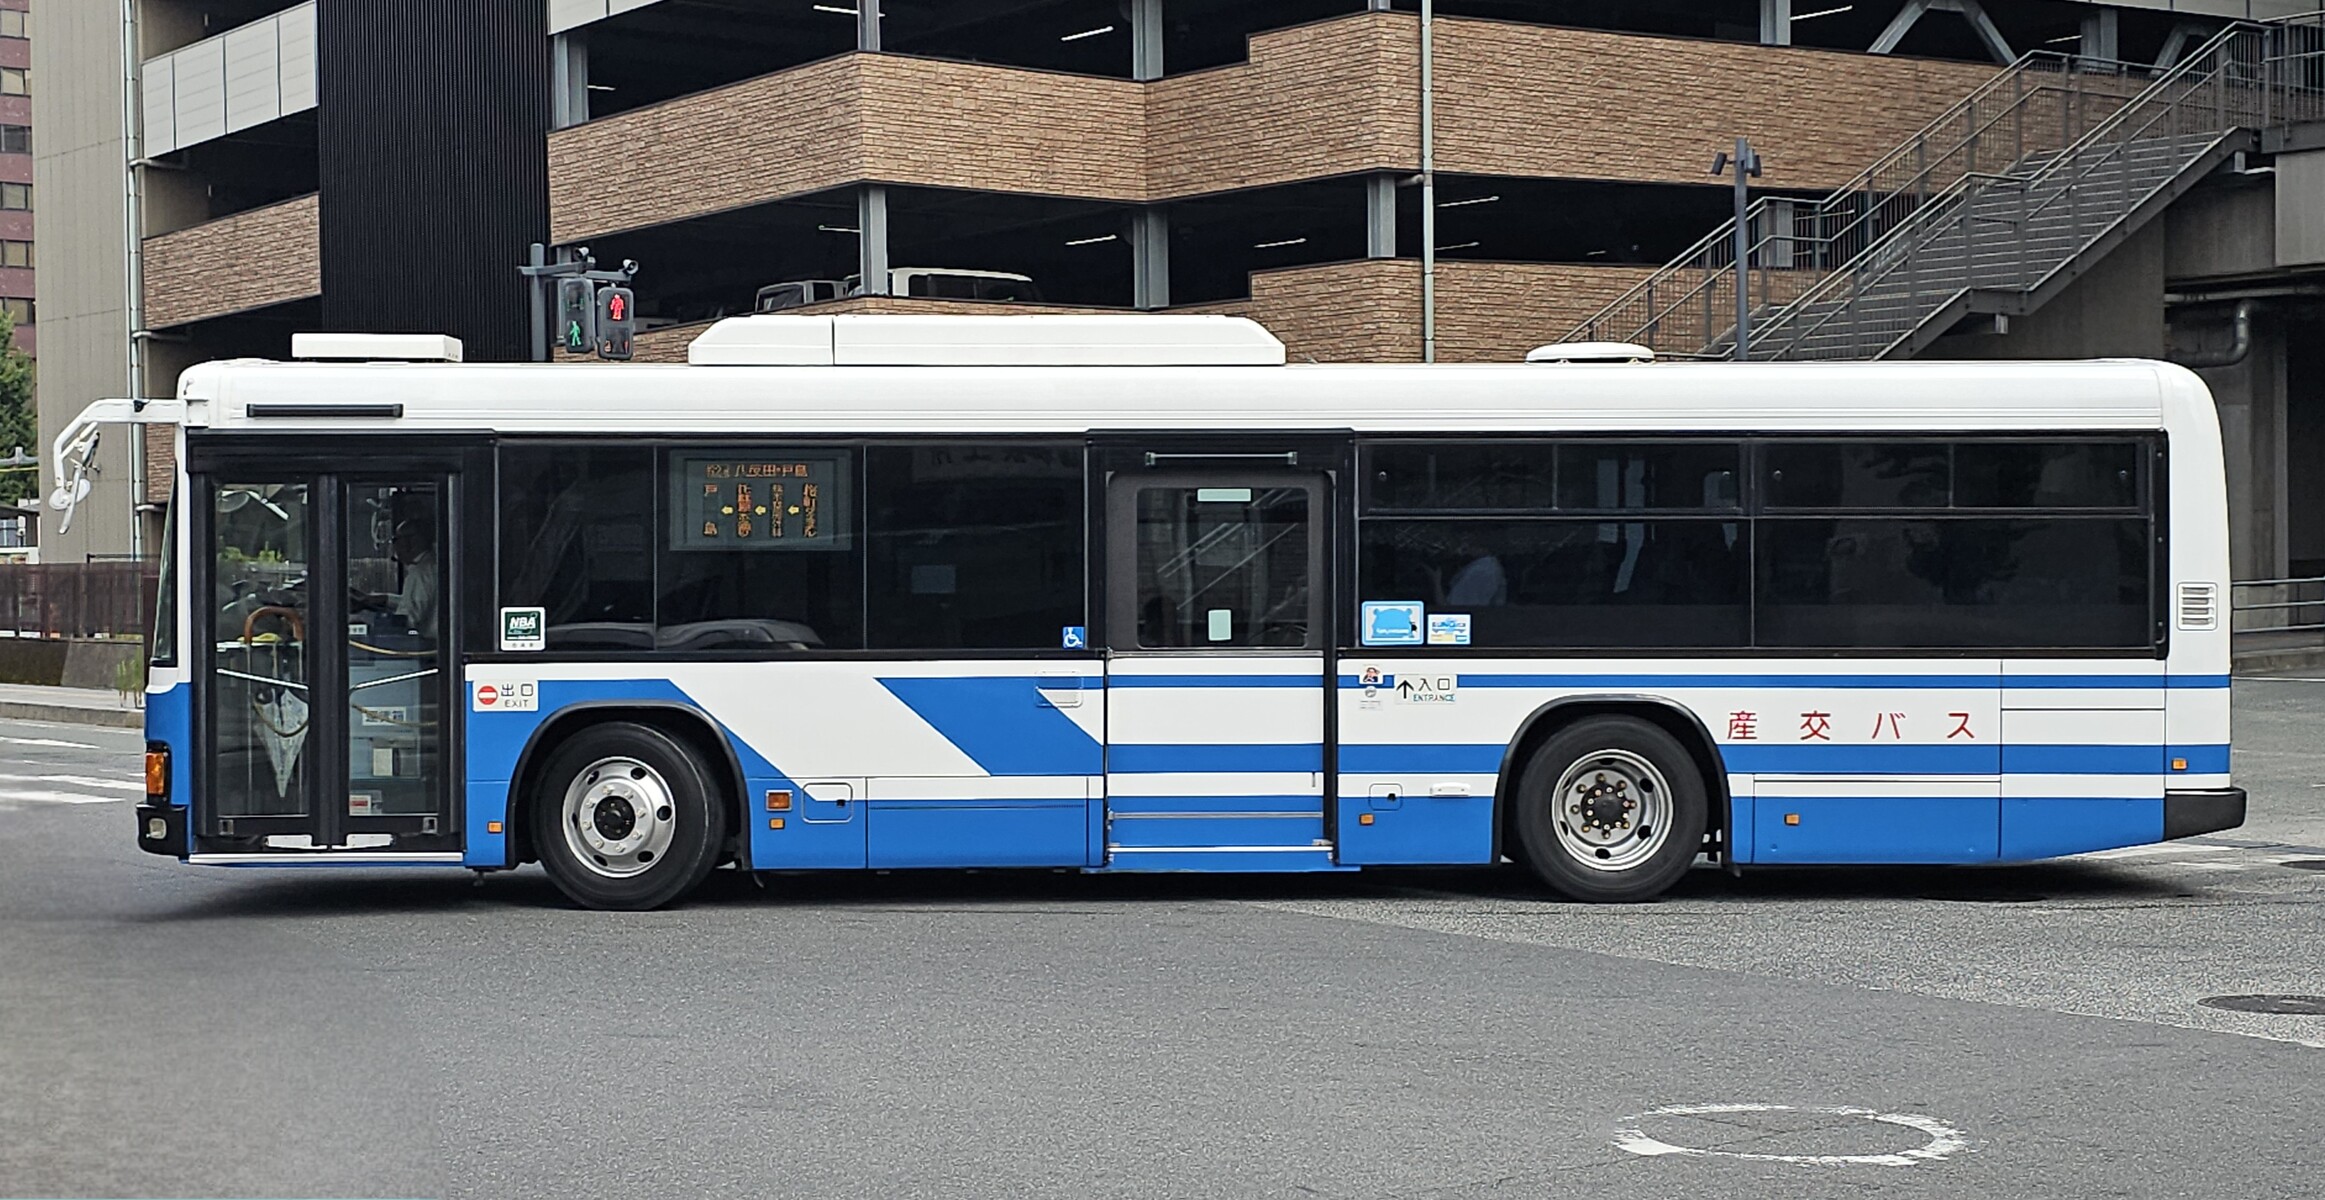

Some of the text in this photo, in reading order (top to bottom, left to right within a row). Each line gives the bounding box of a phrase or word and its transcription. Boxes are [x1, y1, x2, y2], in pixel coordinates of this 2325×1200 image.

[509, 616, 536, 629] NBA
[501, 683, 533, 696] 出口
[1419, 678, 1450, 691] 入口
[504, 699, 529, 708] EXIT
[1413, 694, 1455, 702] ENTRANCE
[1727, 710, 1975, 741] 産交バス
